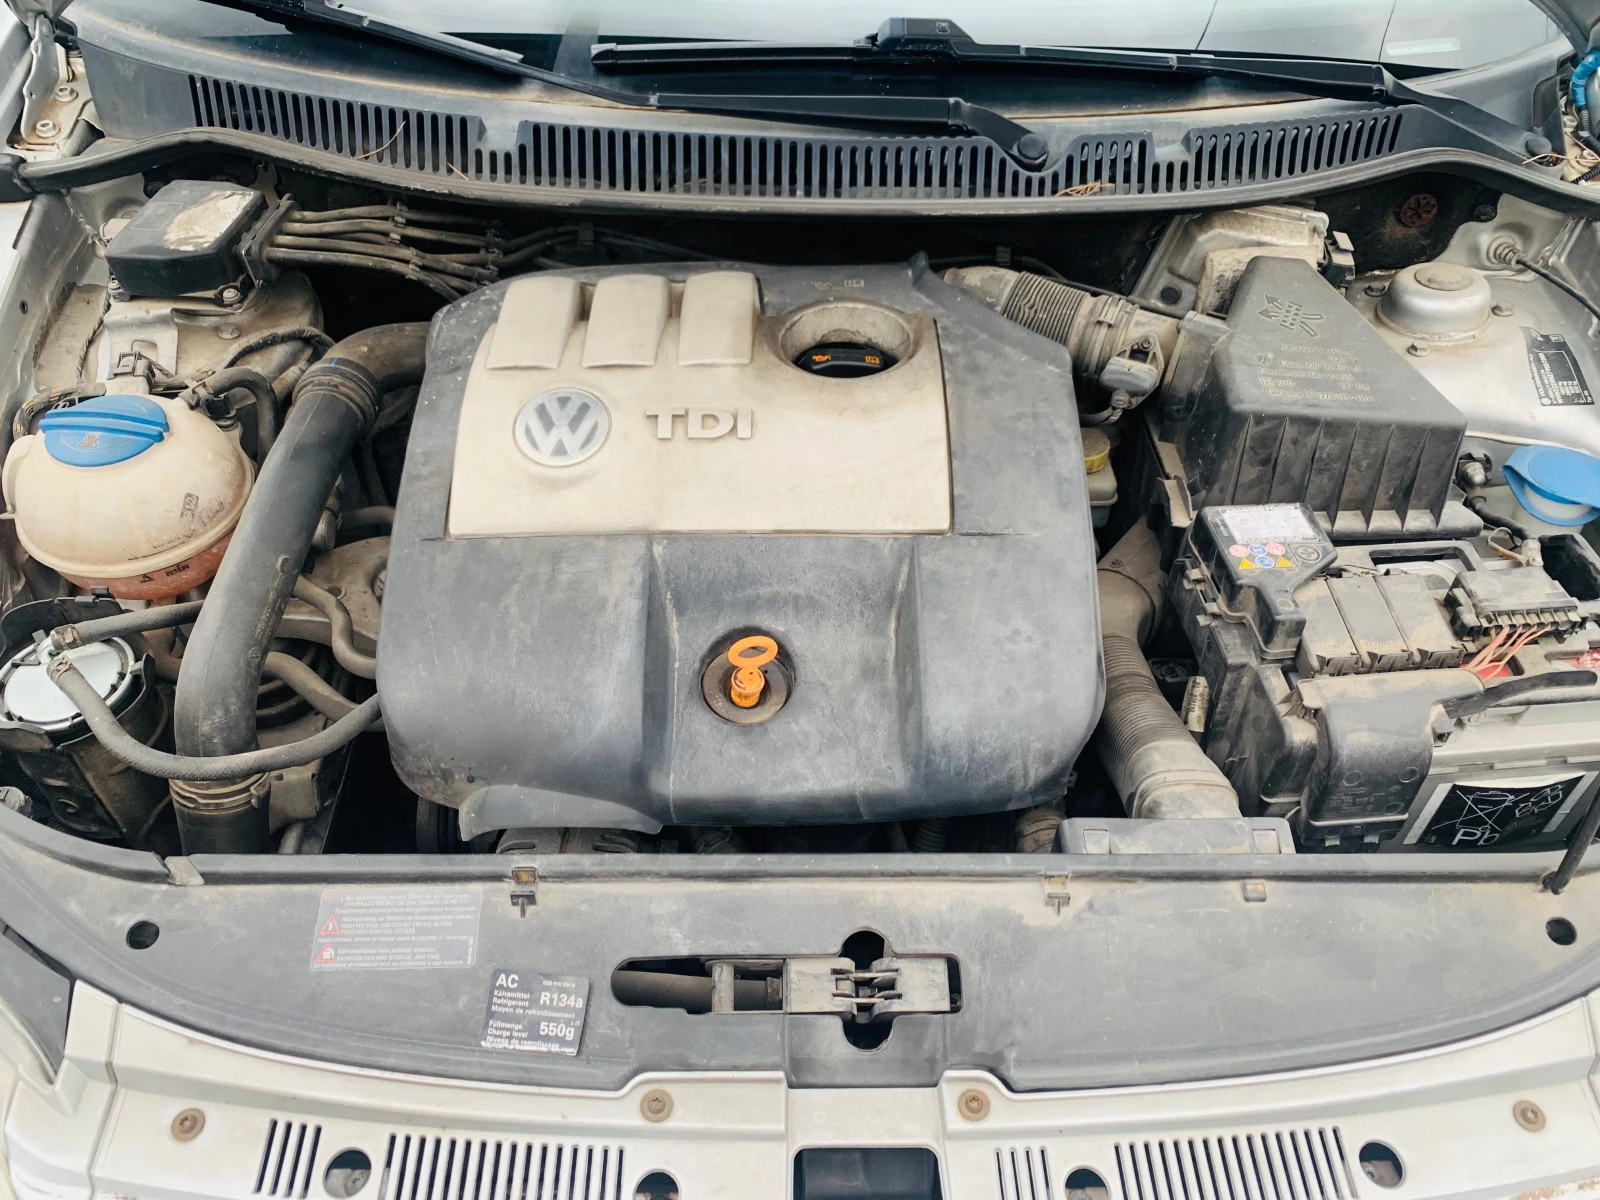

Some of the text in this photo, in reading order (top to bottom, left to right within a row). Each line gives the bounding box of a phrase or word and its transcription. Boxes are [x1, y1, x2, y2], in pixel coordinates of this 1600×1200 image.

[645, 407, 754, 440] TDI
[165, 563, 190, 577] min
[1451, 828, 1500, 846] Pb
[495, 973, 519, 988] AC
[493, 989, 530, 1000] Kältemittel
[540, 991, 583, 1009] R134a
[492, 997, 529, 1007] Refrigerant
[491, 1005, 514, 1014] Moyen
[525, 1008, 575, 1019] refroidissement
[487, 1028, 528, 1038] Charge level
[540, 1021, 575, 1041] 550g
[486, 1035, 509, 1044] Niveau
